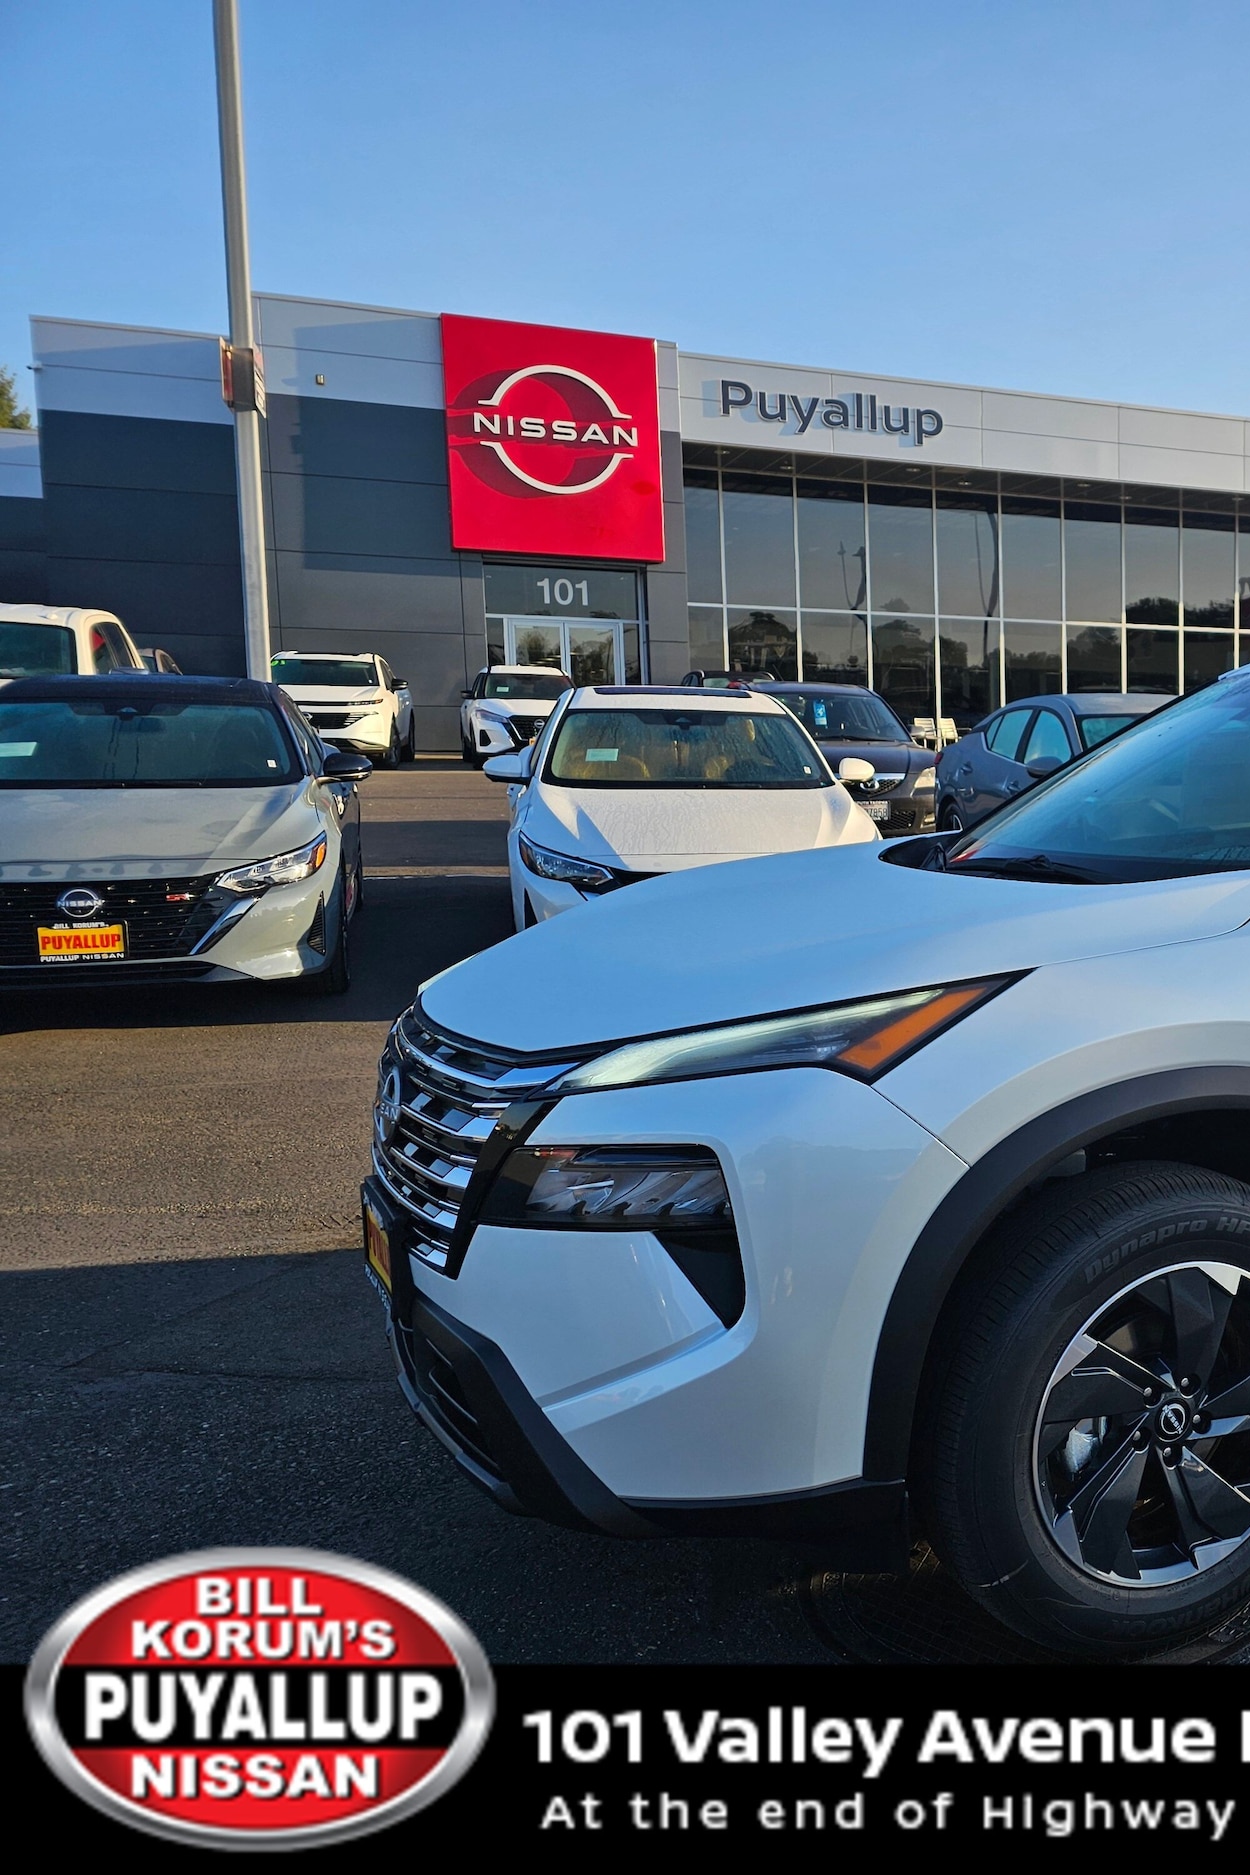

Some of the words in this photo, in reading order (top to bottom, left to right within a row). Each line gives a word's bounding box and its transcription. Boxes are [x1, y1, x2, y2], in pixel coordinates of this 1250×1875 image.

[720, 379, 944, 446] Puyallup
[473, 412, 638, 447] NISSAN
[536, 578, 588, 606] 101
[57, 900, 102, 908] NISSAN
[41, 933, 121, 950] PUYALLUP
[40, 955, 80, 963] PUYALLUP
[82, 952, 125, 961] NISSAN
[1084, 1219, 1207, 1284] Dynapro
